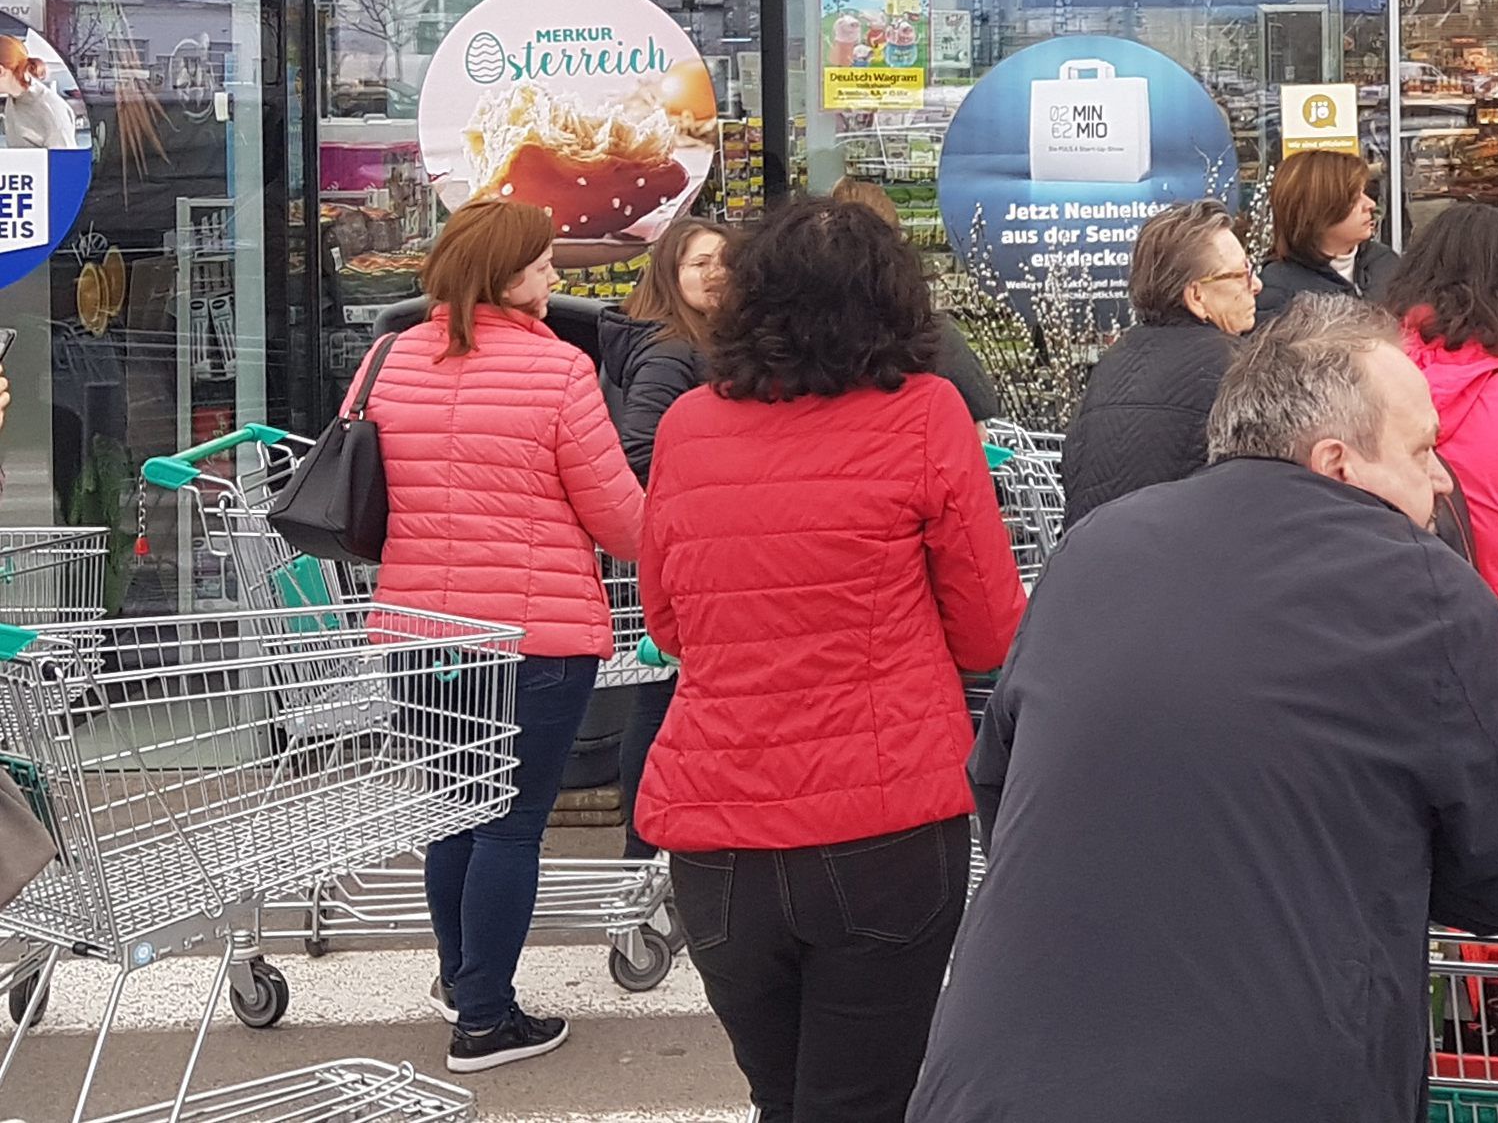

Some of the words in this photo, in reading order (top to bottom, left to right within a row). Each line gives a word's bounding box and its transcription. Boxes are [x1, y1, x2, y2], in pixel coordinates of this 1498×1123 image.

[535, 27, 613, 43] MERKUR
[1073, 104, 1103, 122] MIN
[1076, 122, 1108, 139] MIO
[1005, 203, 1059, 221] Jetzt
[1001, 229, 1038, 244] aus
[1044, 227, 1080, 244] der
[1086, 227, 1140, 242] Send
[1031, 250, 1132, 267] entdecke
